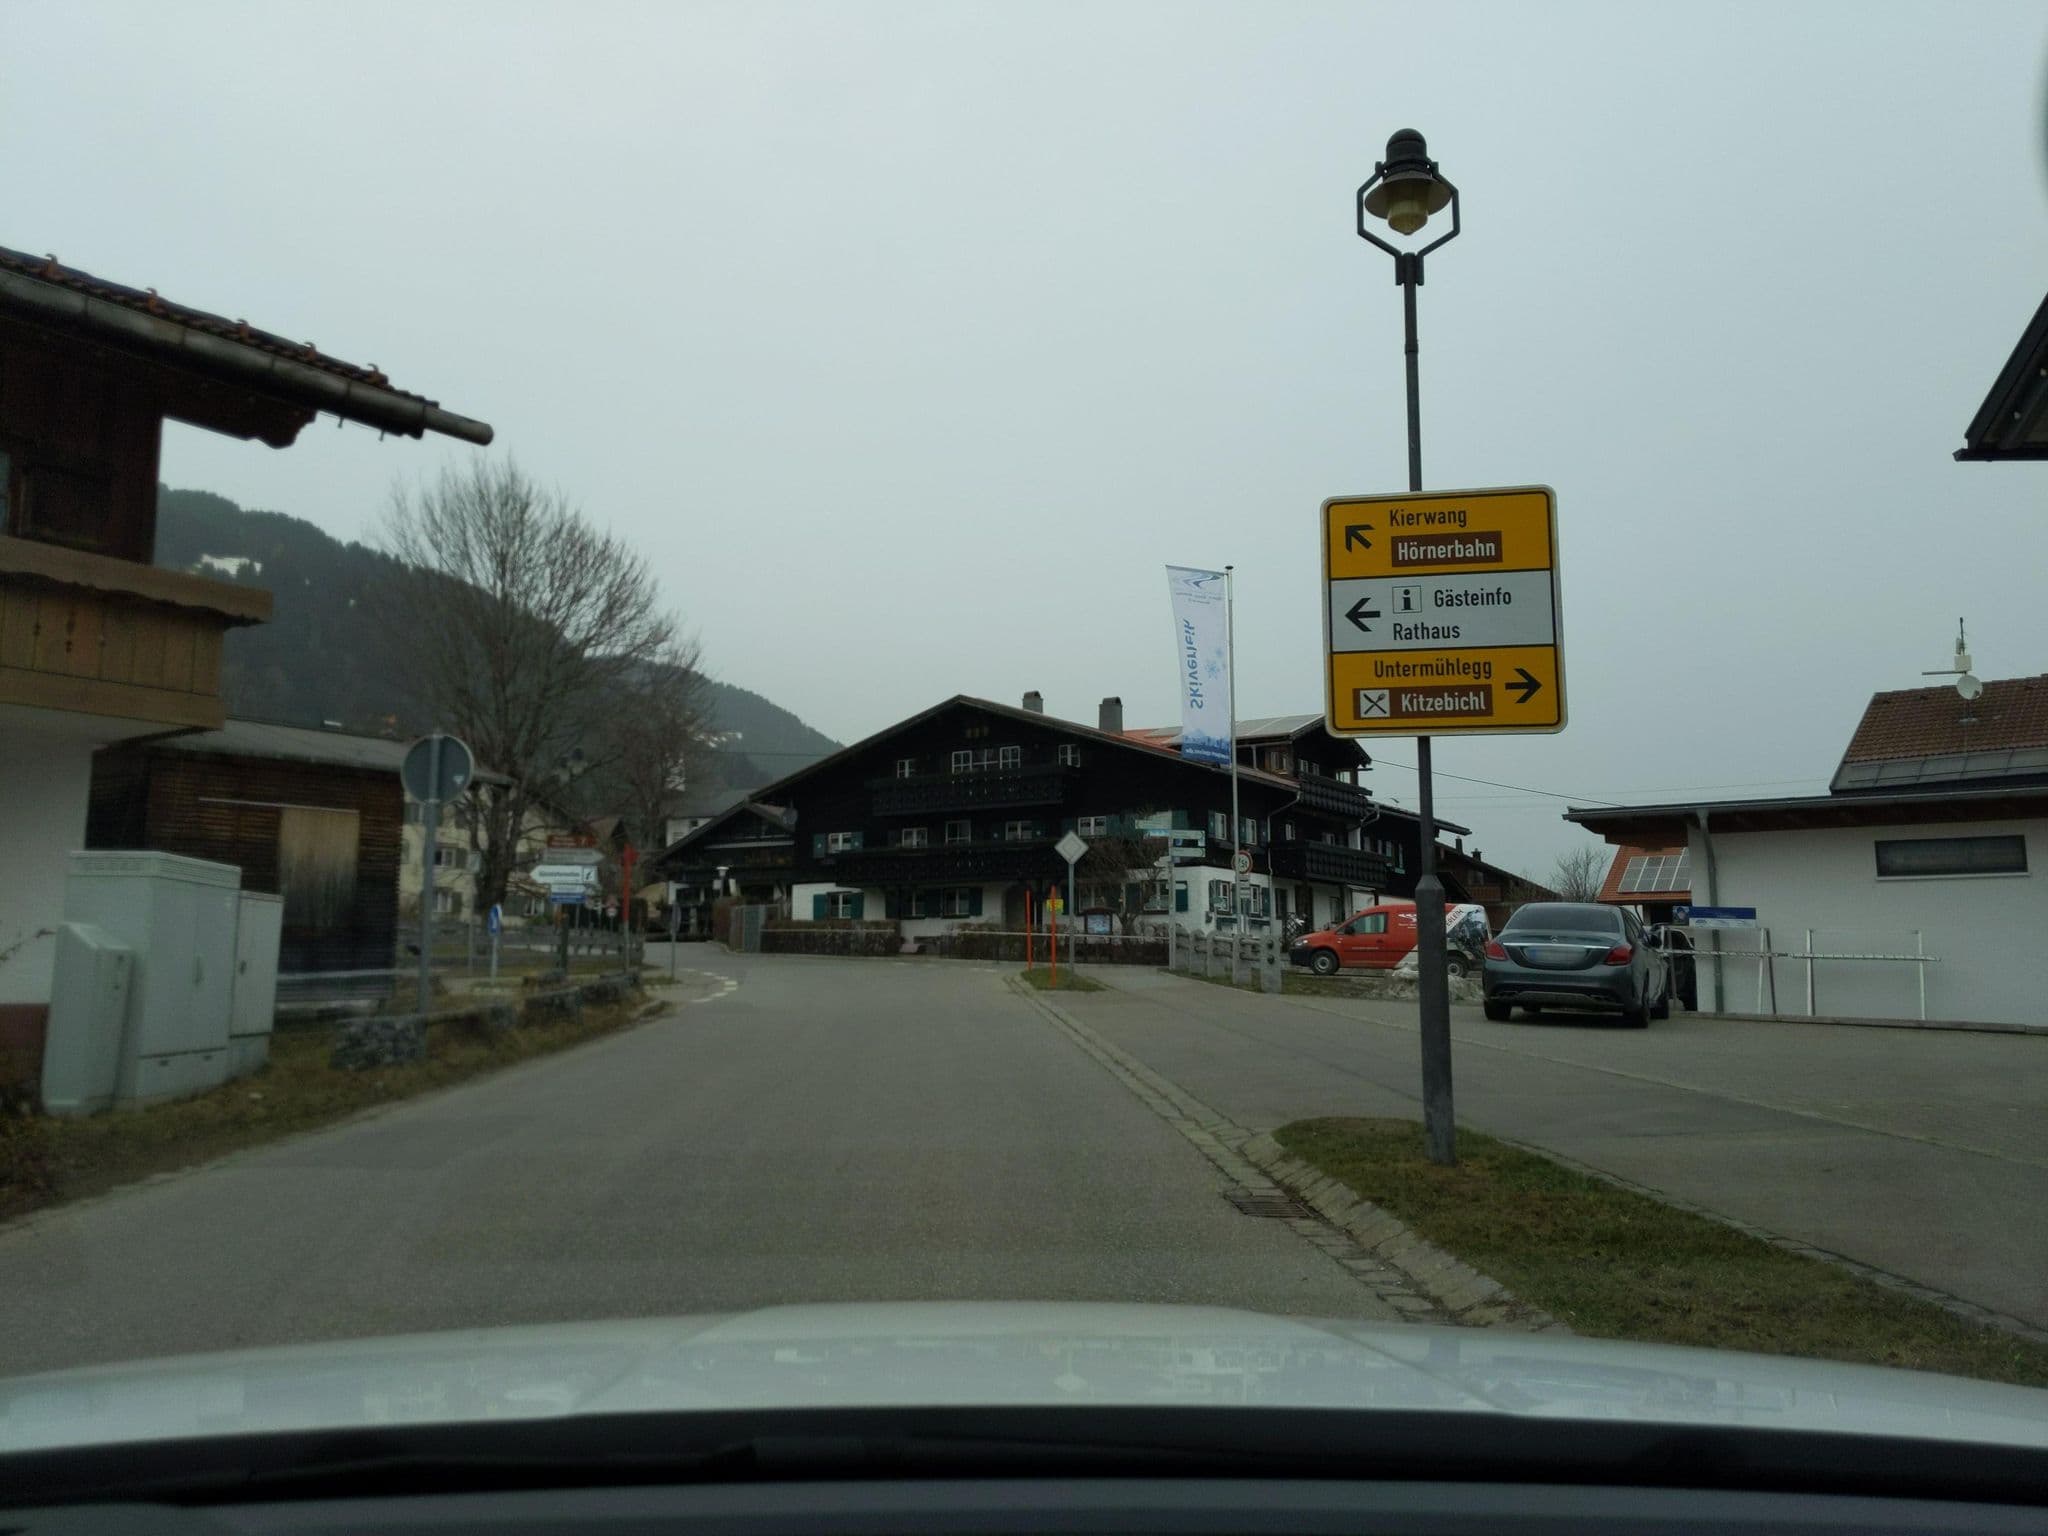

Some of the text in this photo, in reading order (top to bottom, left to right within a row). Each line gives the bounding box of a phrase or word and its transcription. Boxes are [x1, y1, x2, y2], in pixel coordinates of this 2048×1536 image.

[1389, 509, 1467, 528] Kierwang
[1397, 538, 1496, 561] Hörnerbahn
[1434, 587, 1512, 608] Gästeinfo
[1393, 623, 1460, 640] Rathaus
[1374, 658, 1492, 680] Untermühlegg
[1401, 691, 1486, 713] Kitzebichl
